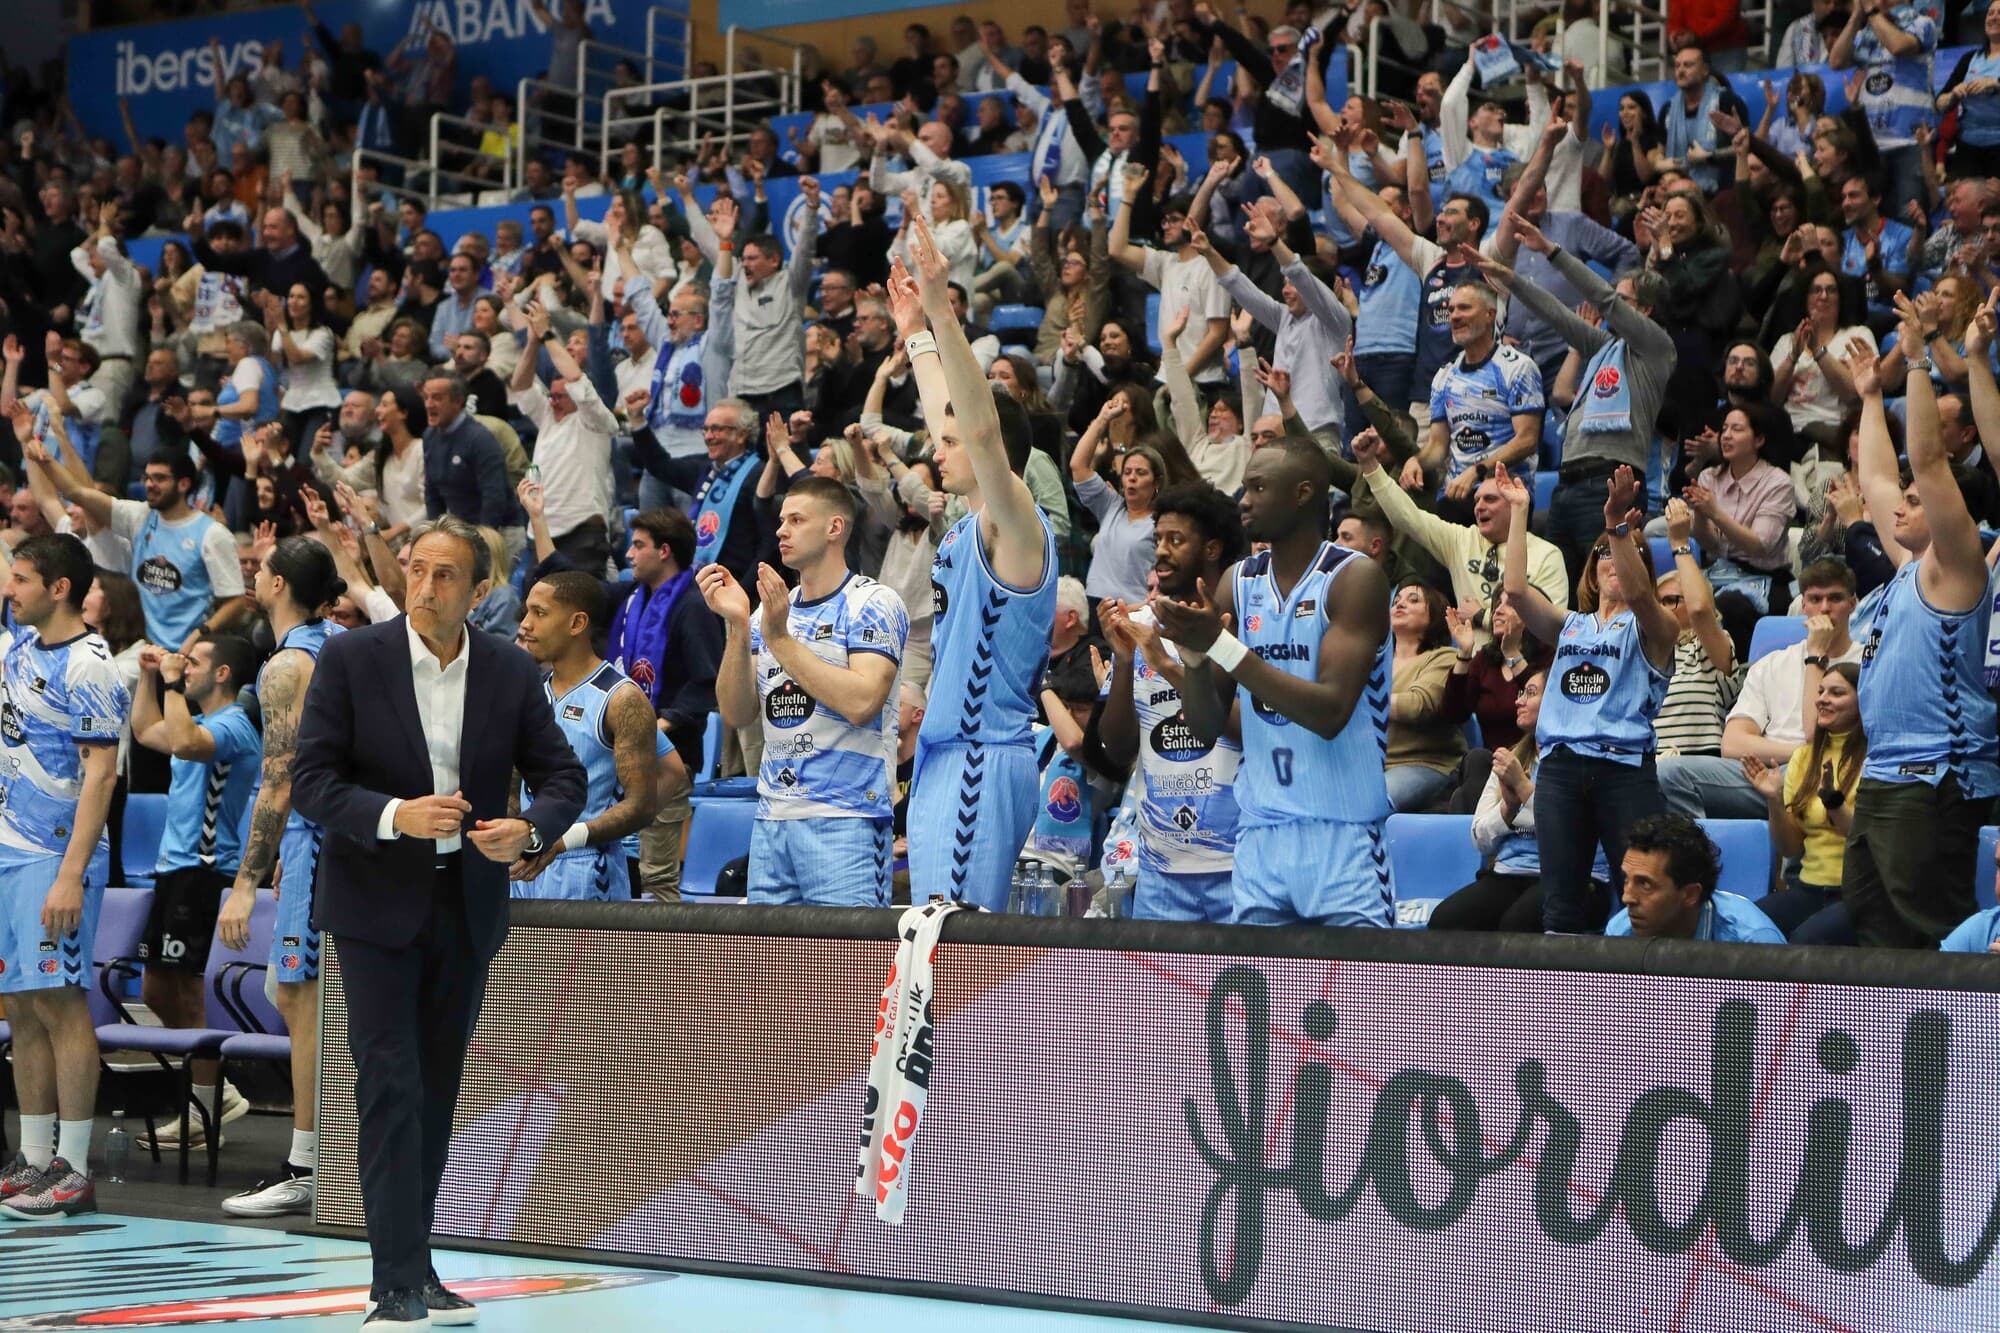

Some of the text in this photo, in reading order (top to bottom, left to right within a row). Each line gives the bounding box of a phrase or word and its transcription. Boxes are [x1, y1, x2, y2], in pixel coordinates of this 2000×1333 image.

[116, 40, 264, 95] ibersys
[1569, 672, 1604, 683] Estrella
[1569, 683, 1602, 695] Galicia
[771, 693, 807, 706] Estrella
[772, 704, 805, 718] Galicia
[1161, 724, 1190, 737] Estre
[1272, 747, 1293, 787] 0
[1162, 779, 1194, 789] LUGO
[1184, 964, 2000, 1306] fiordil
